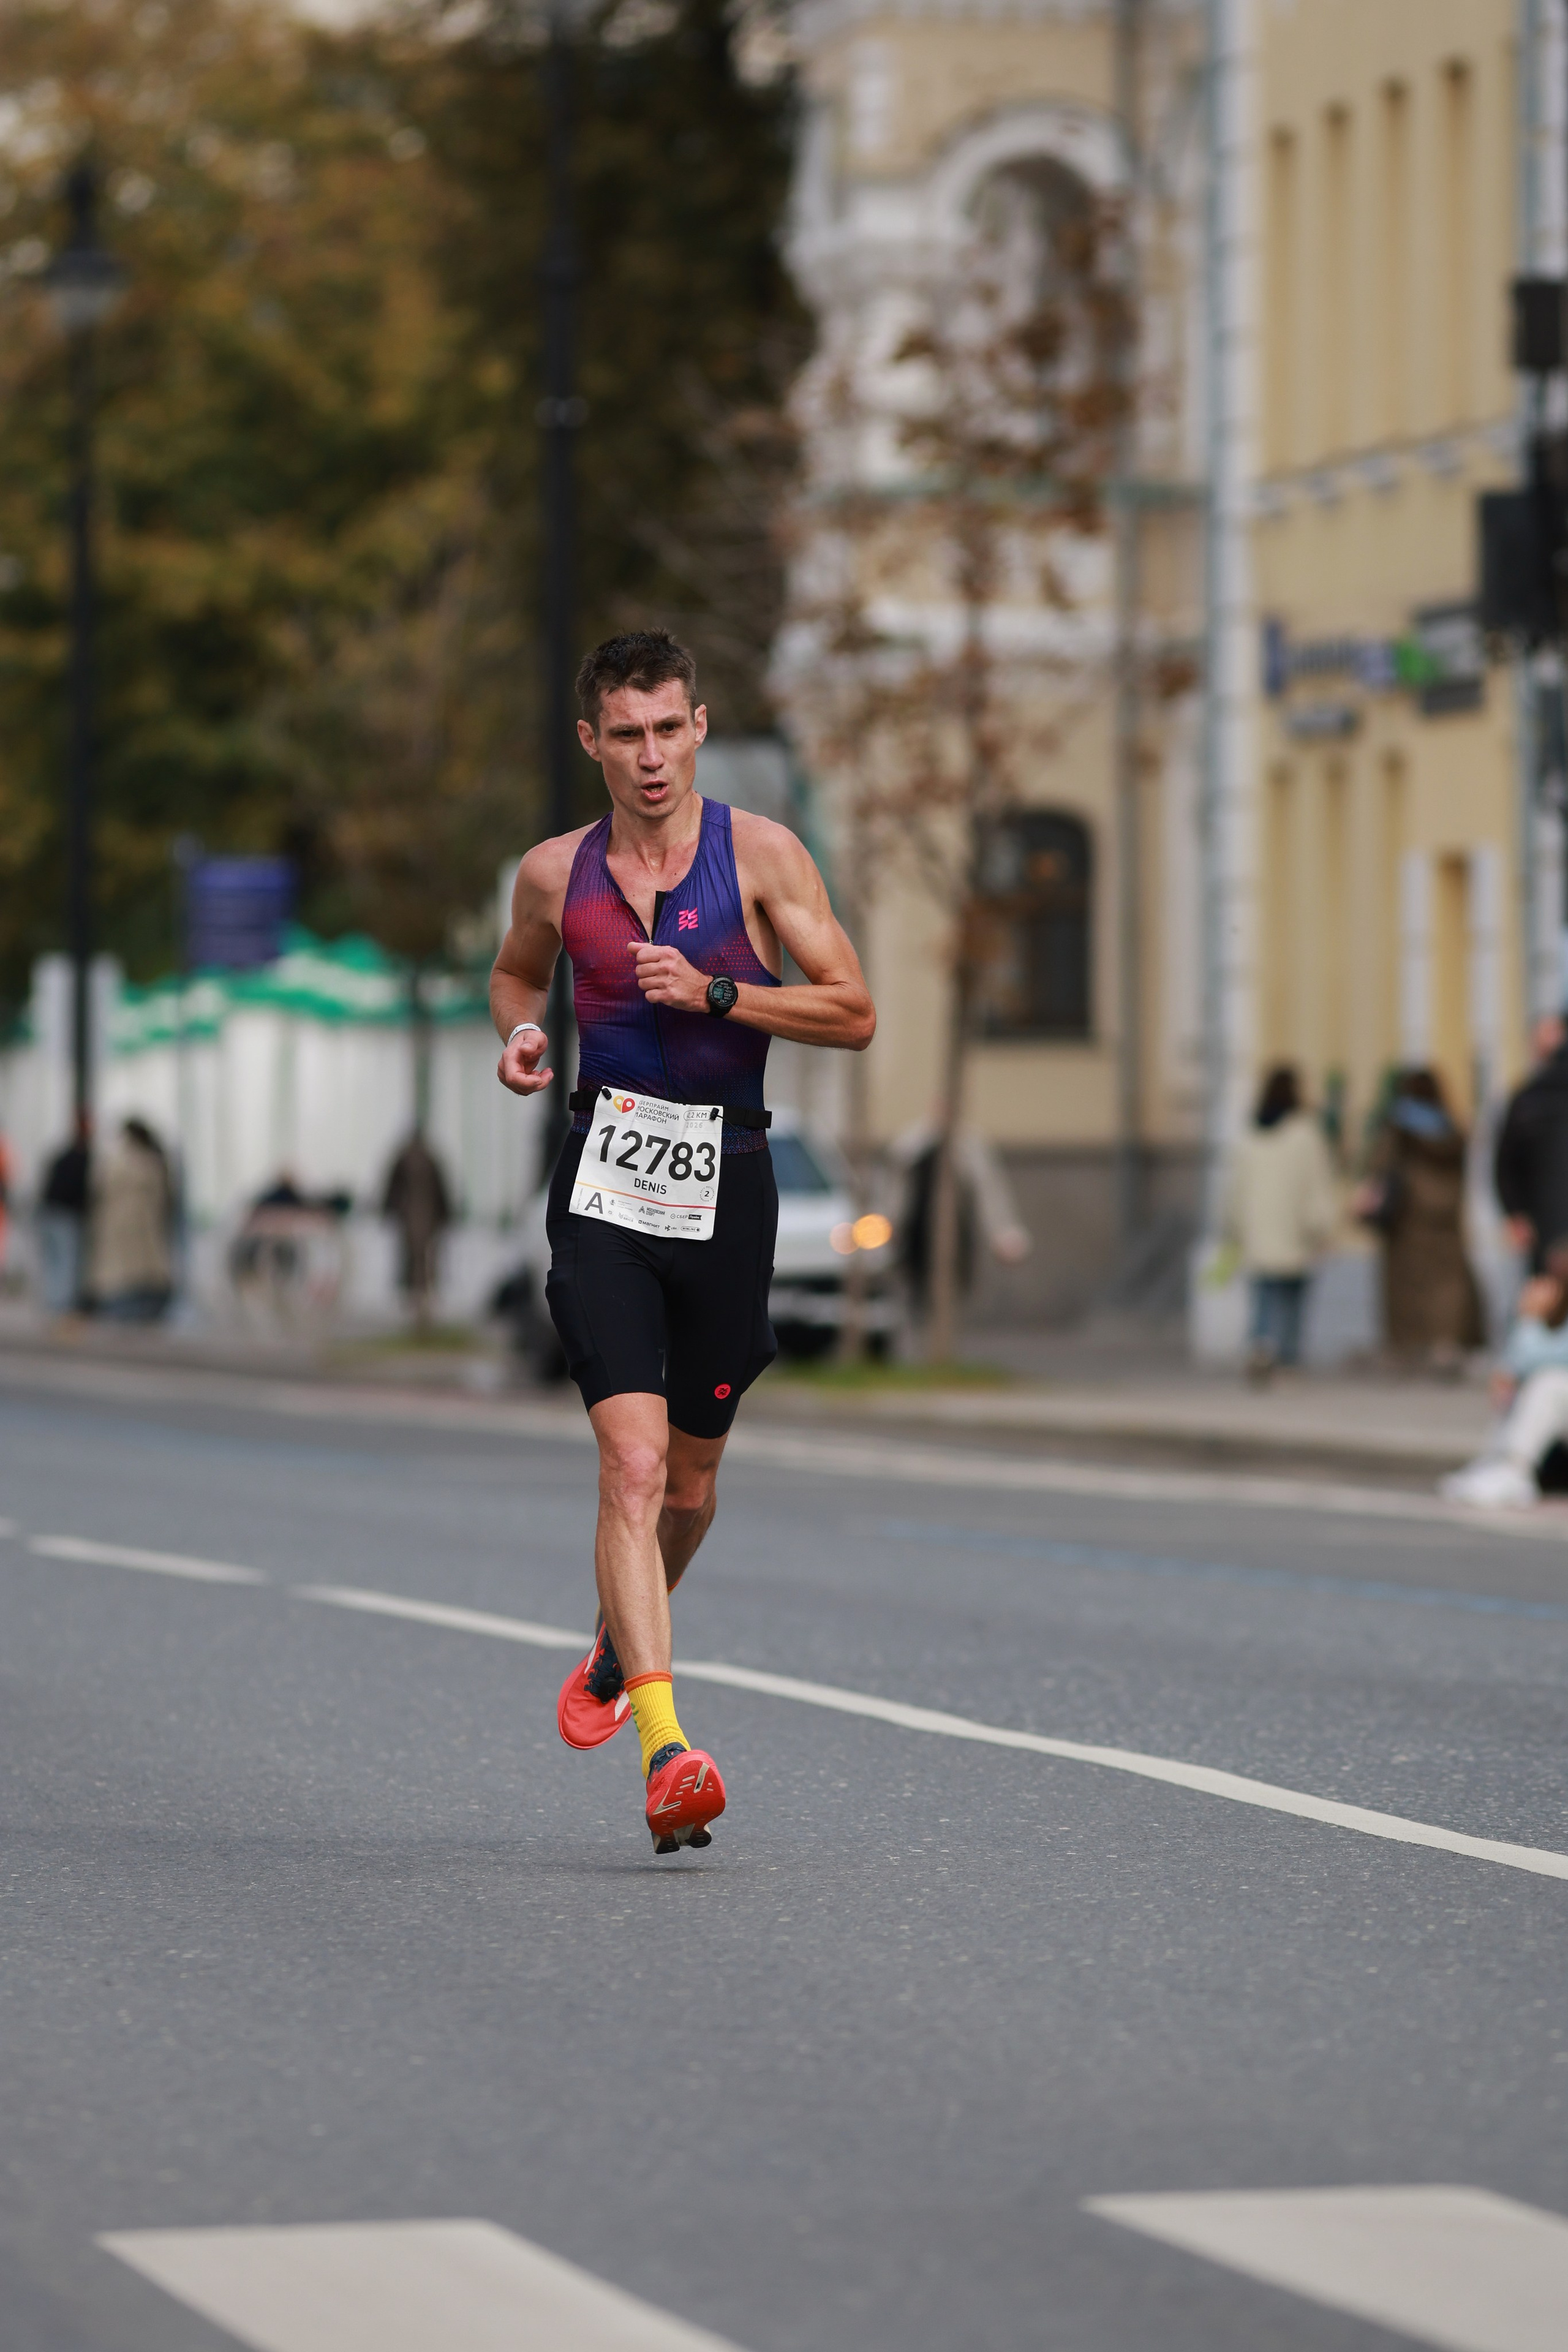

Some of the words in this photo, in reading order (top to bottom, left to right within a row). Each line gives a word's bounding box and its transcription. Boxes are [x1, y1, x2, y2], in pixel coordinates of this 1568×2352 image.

[635, 1112, 667, 1125] МАРАФОН
[636, 1106, 679, 1121] МОСКОВСКИЙ
[598, 1124, 716, 1182] 12783
[634, 1178, 668, 1195] DENIS
[584, 1192, 604, 1215] A
